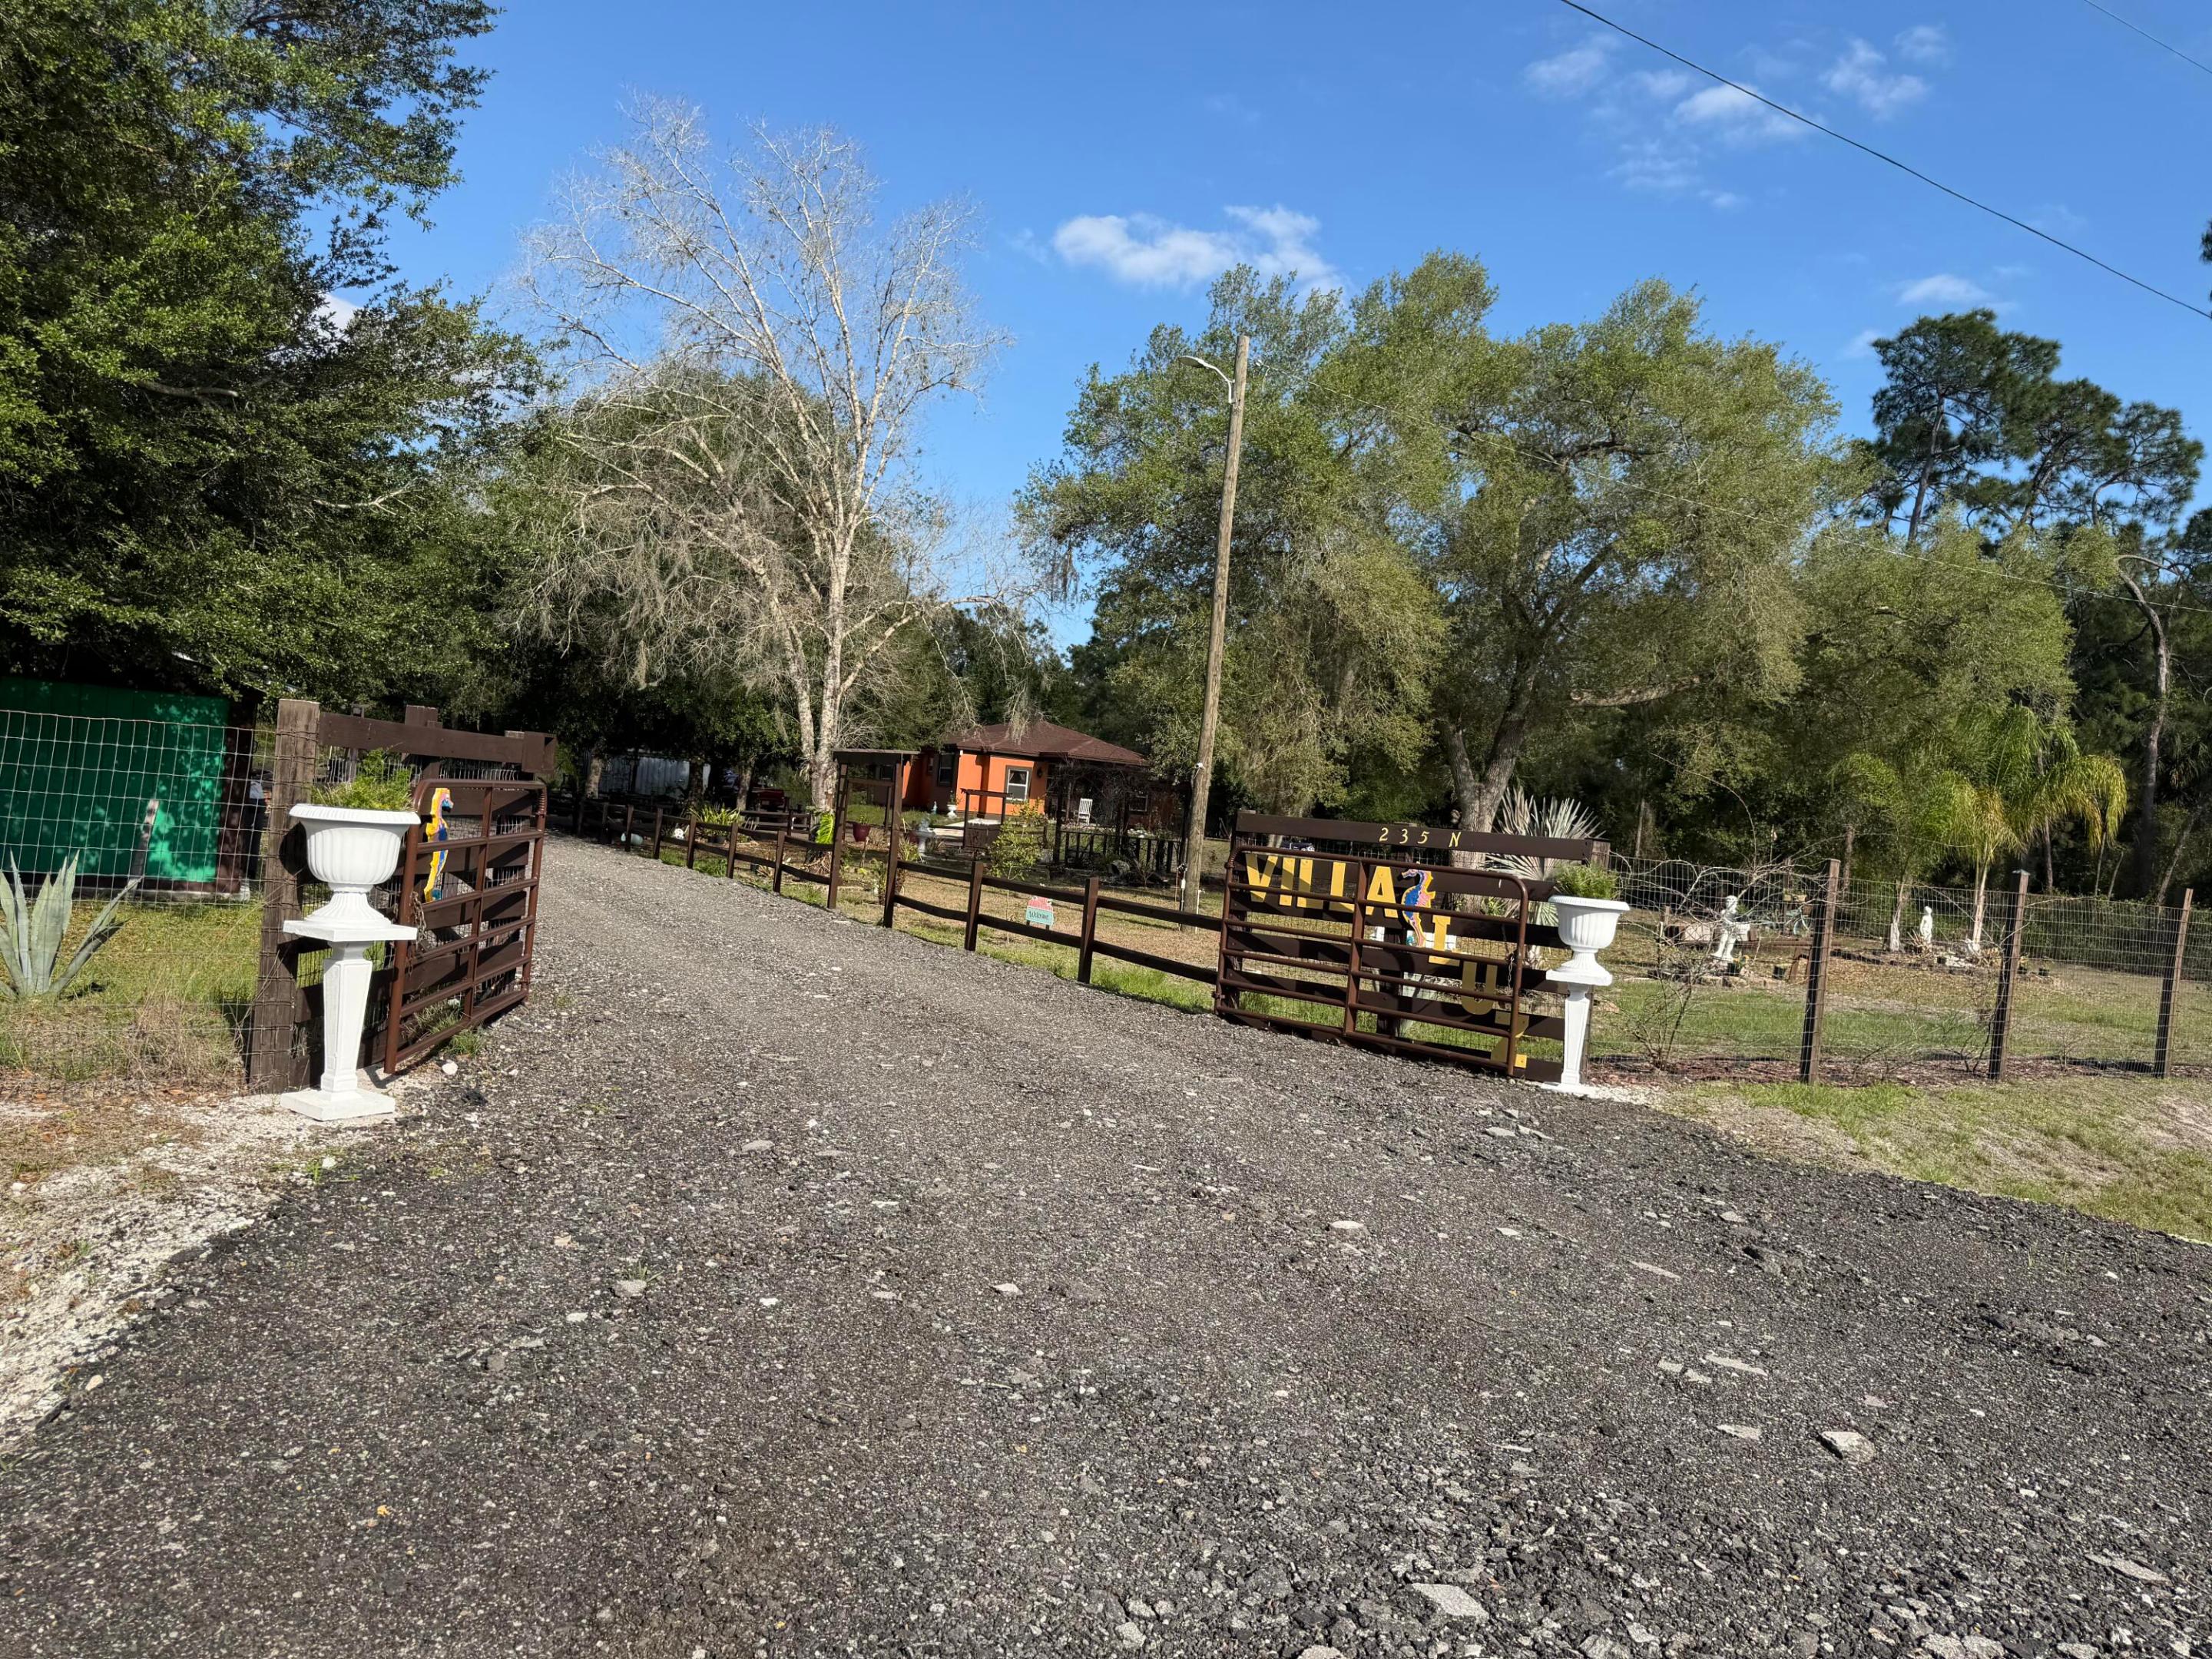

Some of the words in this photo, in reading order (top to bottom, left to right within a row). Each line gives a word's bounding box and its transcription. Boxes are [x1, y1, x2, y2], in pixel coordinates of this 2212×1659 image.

[1379, 827, 1430, 844] 235
[1449, 831, 1462, 848] N
[1245, 853, 1399, 919] VILLA
